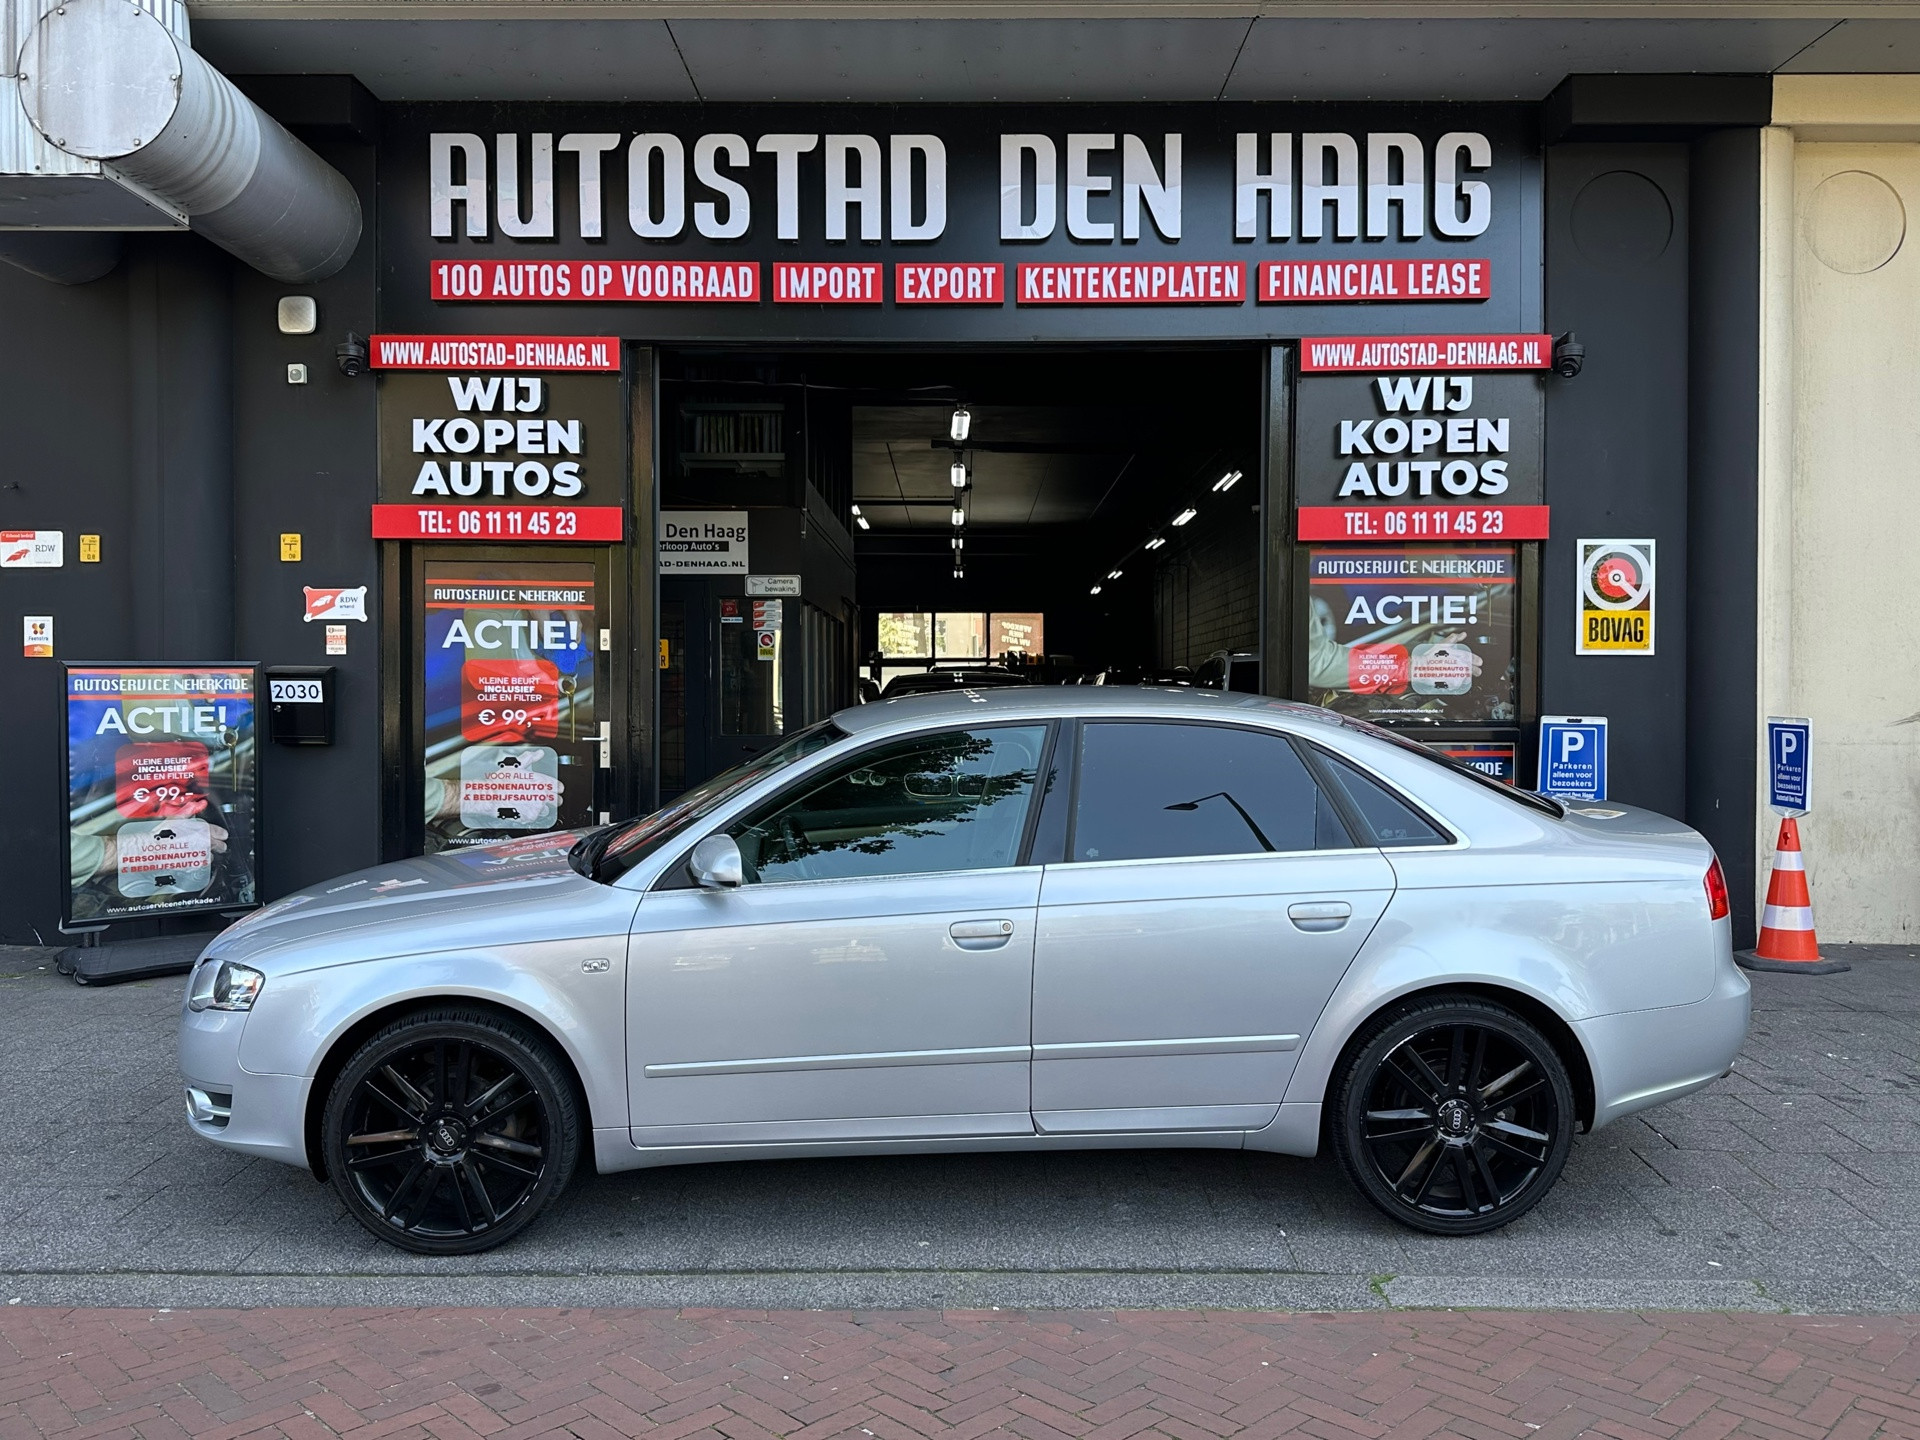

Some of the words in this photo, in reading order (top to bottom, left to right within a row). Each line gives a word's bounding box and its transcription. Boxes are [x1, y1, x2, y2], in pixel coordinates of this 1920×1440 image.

[430, 133, 947, 240] AUTOSTAD
[1000, 133, 1182, 240] DEN
[1235, 132, 1492, 238] HAAG
[438, 264, 482, 297] 100
[492, 265, 570, 297] AUTOS
[582, 266, 613, 297] OP
[621, 266, 753, 298] VOORRAAD
[780, 266, 876, 299] IMPORT
[903, 266, 996, 299] EXPORT
[1024, 264, 1239, 298] KENTEKENPLATEN
[1269, 263, 1399, 296] FINANCIAL
[1408, 262, 1481, 296] LEASE
[380, 341, 609, 367] WWW.AUTOSTAD-DENHAAG.NL
[1311, 341, 1541, 366] WWW.AUTOSTAD-DENHAAG.NL
[448, 377, 542, 412] WIJ
[1377, 376, 1473, 412] WIJ
[412, 418, 580, 454] KOPEN
[1340, 418, 1509, 454] KOPEN
[411, 461, 582, 496] AUTOS
[1338, 460, 1509, 496] AUTOS
[418, 510, 451, 533] TEL:
[458, 511, 480, 534] 06
[486, 511, 501, 534] 11
[507, 511, 522, 534] 11
[528, 512, 550, 534] 45
[556, 512, 576, 535] 23
[1345, 512, 1377, 535] TEL:
[1384, 511, 1406, 534] 06
[1412, 511, 1428, 534] 11
[1433, 511, 1448, 534] 11
[1454, 511, 1476, 534] 45
[1482, 510, 1503, 533] 23
[666, 523, 699, 538] Den
[704, 523, 746, 542] Haag
[35, 544, 55, 552] RDW
[690, 542, 719, 551] Auto's
[1317, 560, 1418, 575] AUTOSERVICE
[1422, 559, 1505, 574] NEHERKADE
[764, 585, 796, 593] bewaking
[767, 577, 794, 585] Camera
[433, 588, 516, 601] AUTOSERVICE
[518, 589, 586, 602] NEHERKADE
[1344, 595, 1478, 625] ACTIE!
[442, 619, 579, 650] ACTIE!
[1588, 617, 1644, 643] BOVAG
[74, 679, 170, 692] AUTOSERVICE
[173, 678, 248, 691] NEHERKADE
[478, 677, 509, 685] KLEINE
[511, 677, 540, 685] BEURT
[1359, 674, 1370, 685] €
[1373, 674, 1398, 686] 99,-
[274, 684, 319, 699] 2030
[95, 706, 228, 735] ACTIE!
[478, 709, 496, 725] €
[502, 709, 541, 728] 99,-
[1562, 731, 1585, 762] P
[1781, 732, 1797, 764] P
[132, 758, 163, 766] KLEINE
[164, 757, 192, 765] BEURT
[138, 765, 188, 773] INCLUSIEF
[1552, 762, 1592, 770] Parkeren
[1777, 763, 1801, 773] Parkeren
[131, 773, 151, 781] OLIE
[484, 772, 511, 780] VOOR
[513, 772, 534, 780] ALLE
[133, 788, 150, 803] €
[155, 786, 194, 803] 99,-
[465, 783, 553, 791] PERSONENAUTO'S
[1777, 782, 1801, 791] bezoekers
[473, 794, 555, 802] BEDRIJFSAUTO'S
[122, 850, 207, 863] PERSONENAUTO'S
[142, 844, 167, 852] VOOR
[169, 842, 189, 850] ALLE
[130, 859, 208, 873] BEDRIJFSAUTO'S
